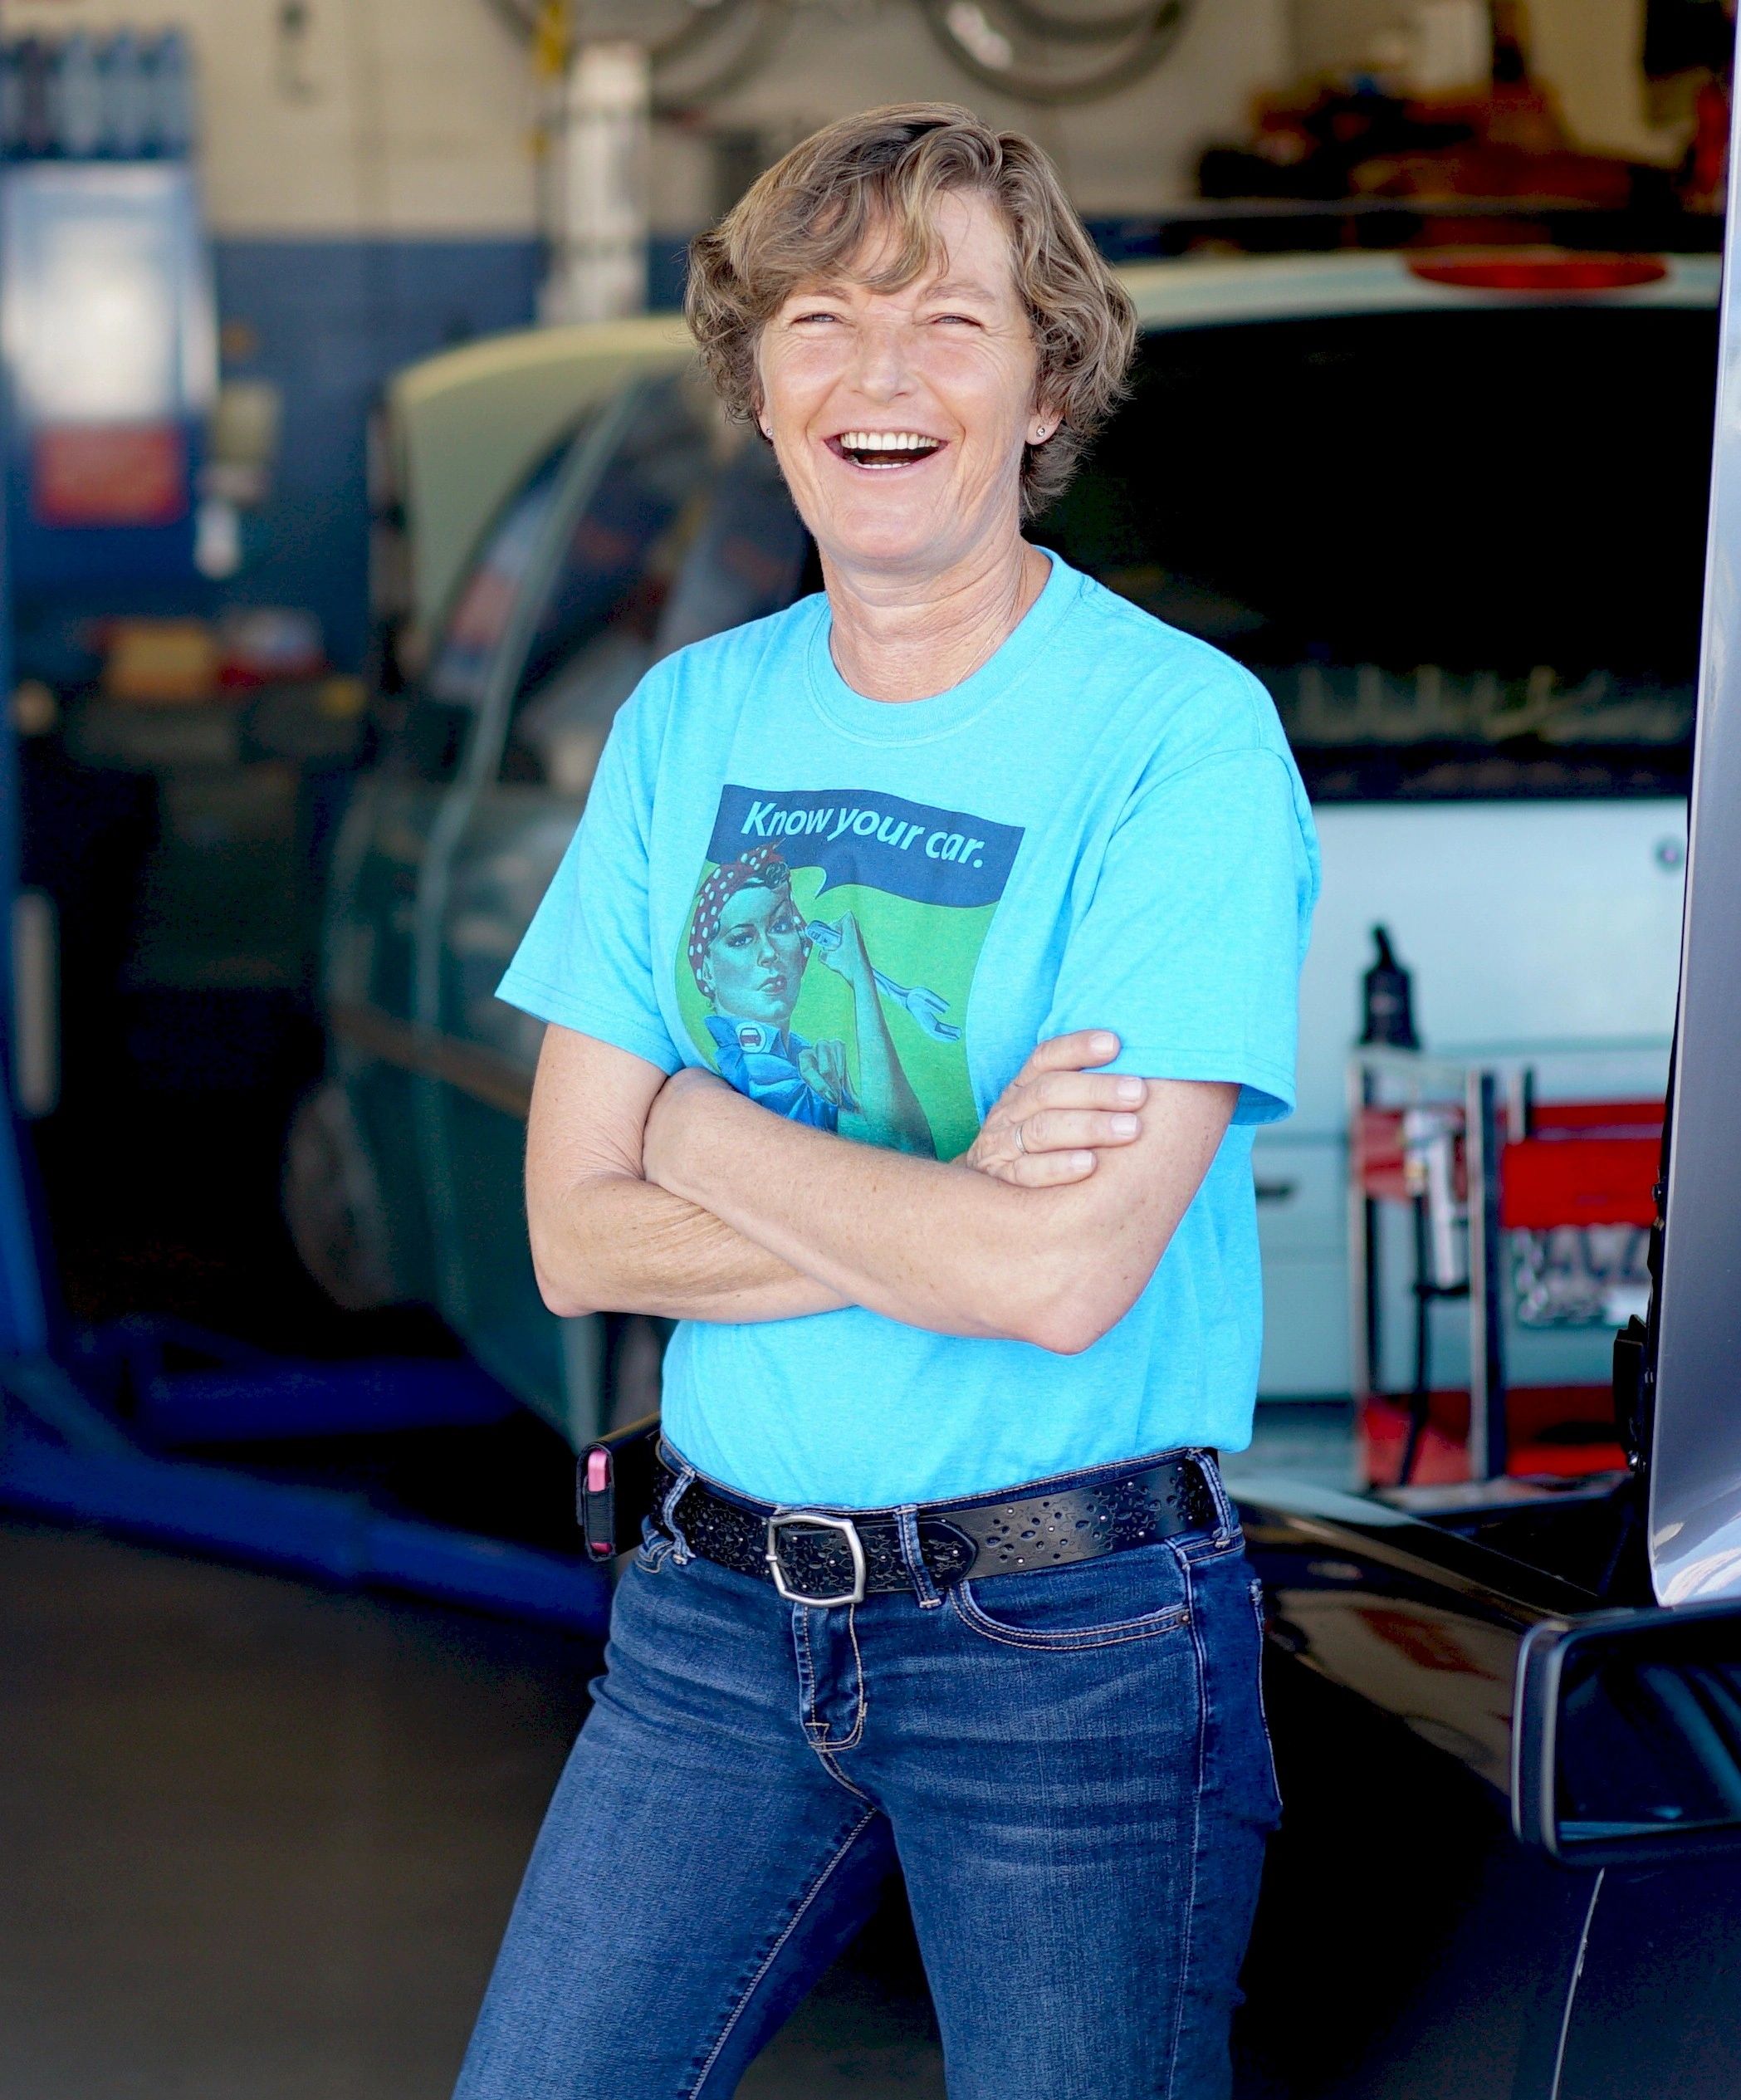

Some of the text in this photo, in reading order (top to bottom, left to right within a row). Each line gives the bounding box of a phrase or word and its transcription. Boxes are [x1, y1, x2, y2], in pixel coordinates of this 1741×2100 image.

[741, 801, 985, 869] Know your car.
